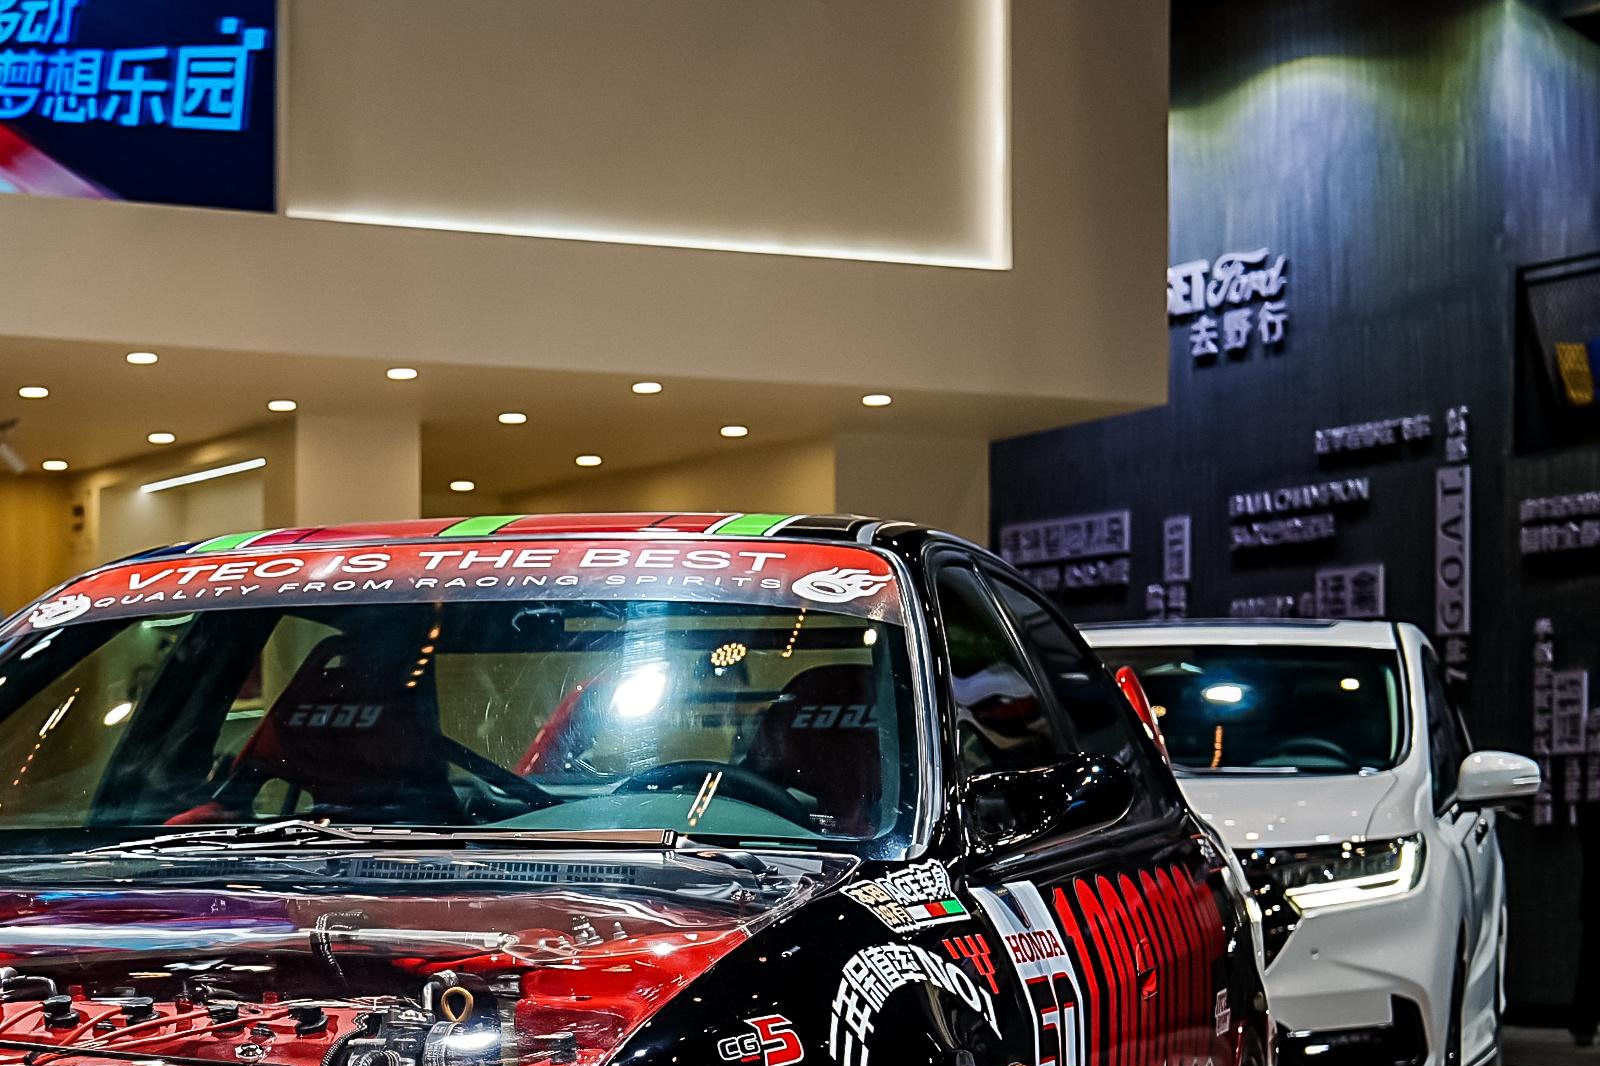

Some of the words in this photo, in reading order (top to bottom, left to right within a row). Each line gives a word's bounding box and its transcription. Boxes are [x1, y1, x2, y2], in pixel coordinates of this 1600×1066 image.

[129, 558, 303, 591] VTEC
[314, 553, 391, 579] IS
[418, 549, 560, 571] THE
[579, 549, 787, 572] BEST
[94, 584, 261, 609] QUALITY
[278, 578, 394, 593] FROM
[414, 575, 579, 590] RACING
[606, 575, 782, 590] SPIRITS
[1005, 929, 1066, 965] HONDA
